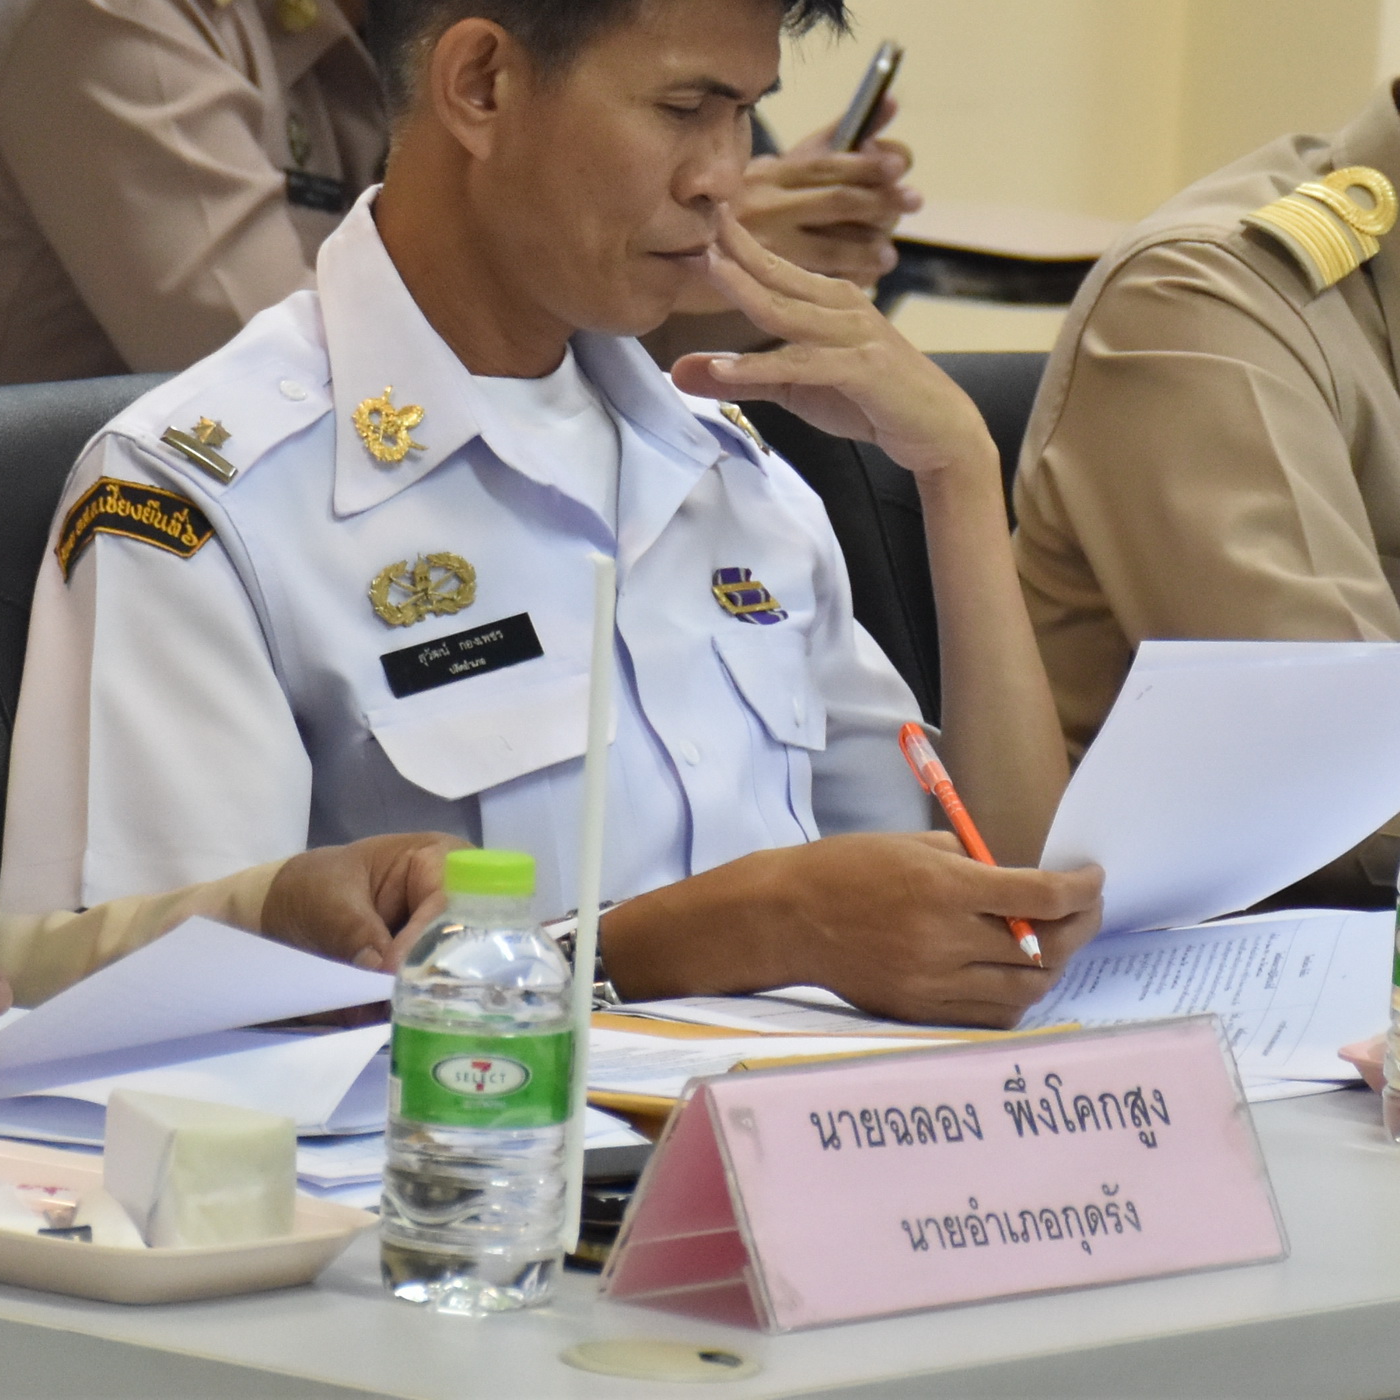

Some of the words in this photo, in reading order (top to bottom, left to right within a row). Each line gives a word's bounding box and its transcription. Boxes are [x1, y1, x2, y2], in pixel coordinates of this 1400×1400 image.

[456, 1071, 506, 1084] SELECT
[809, 1102, 984, 1150] นายฉลอง
[1002, 1064, 1171, 1150] พึ่งโคกสูง
[901, 1183, 1141, 1255] นายอำเภอกุดรัง
